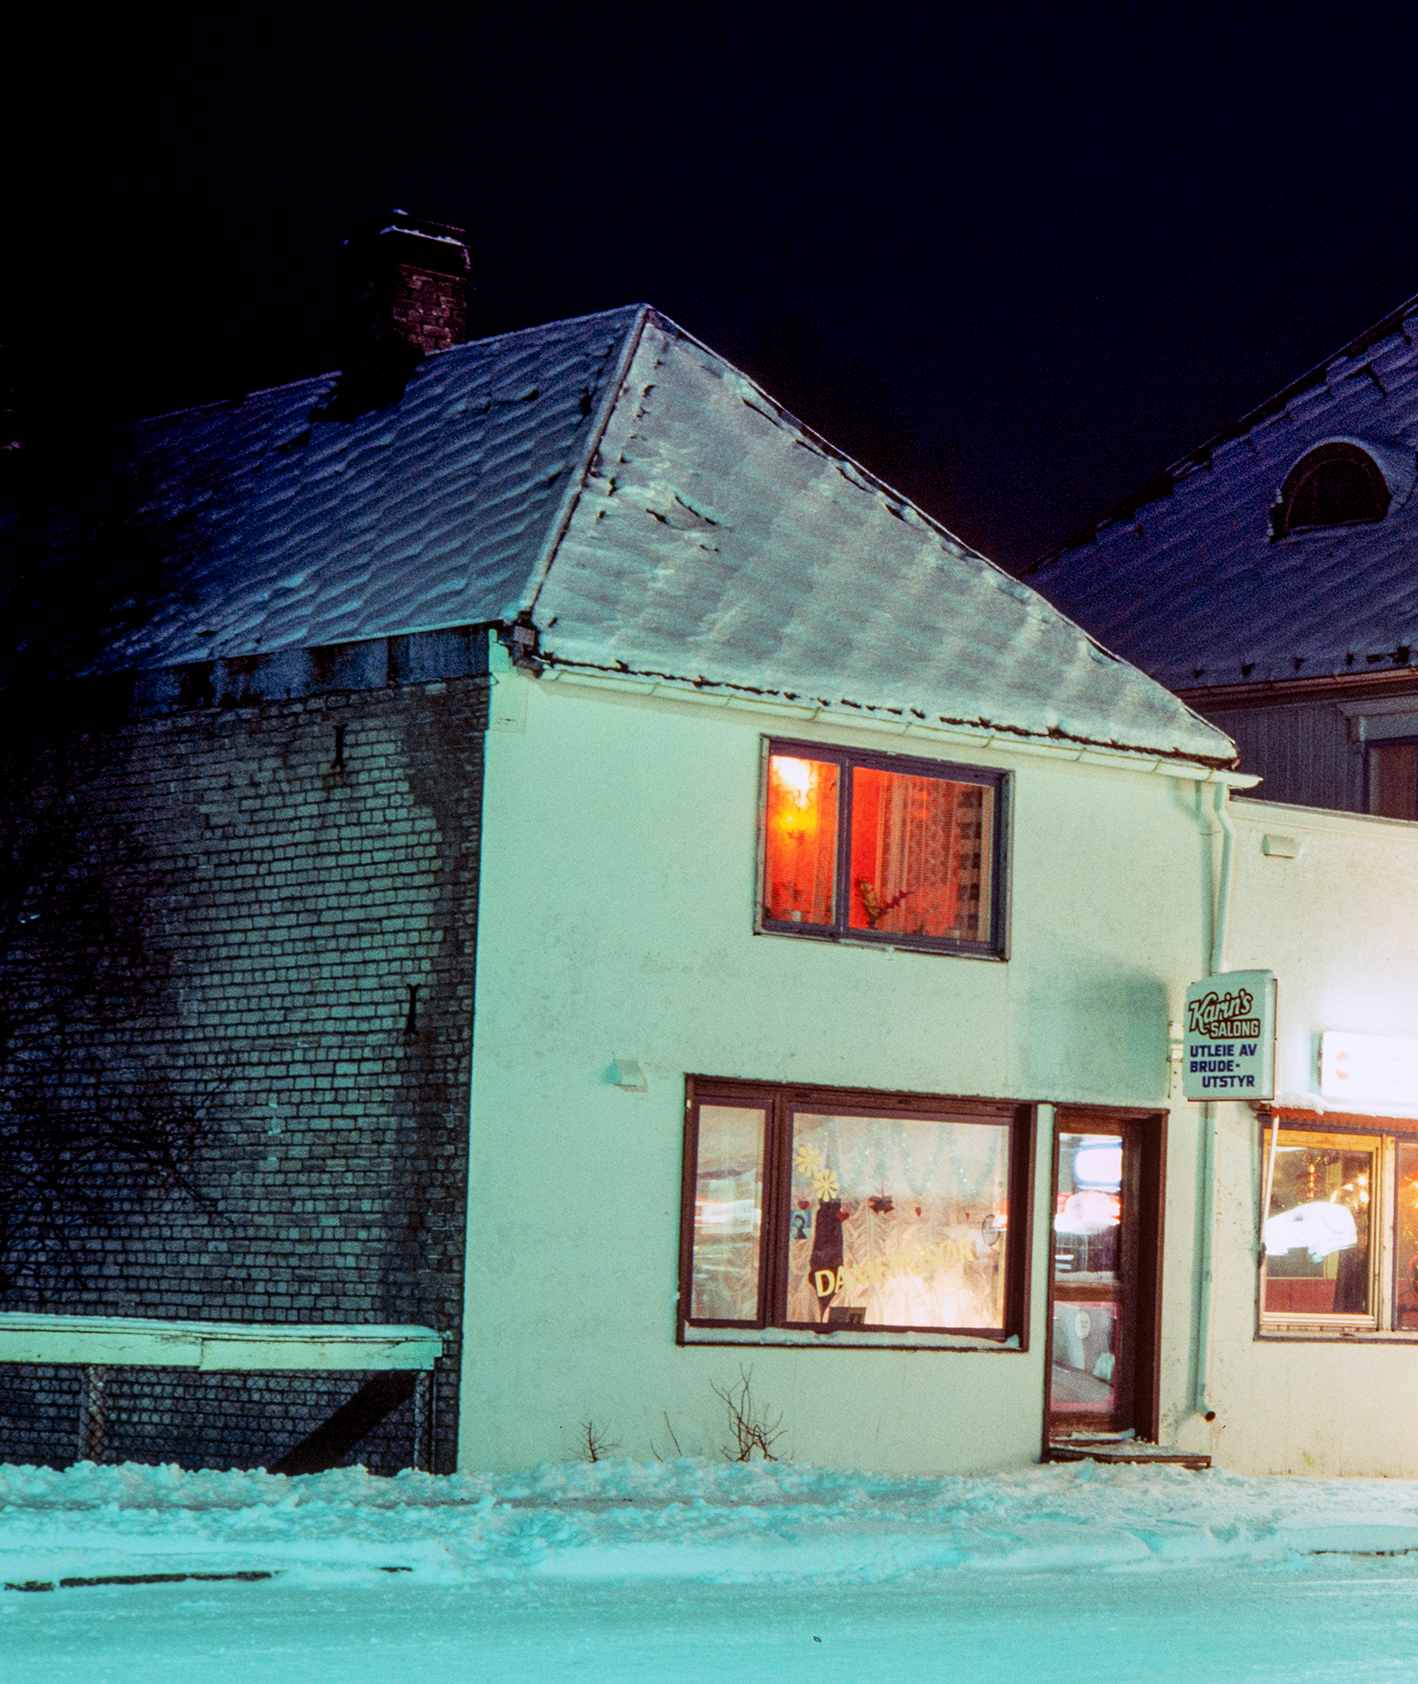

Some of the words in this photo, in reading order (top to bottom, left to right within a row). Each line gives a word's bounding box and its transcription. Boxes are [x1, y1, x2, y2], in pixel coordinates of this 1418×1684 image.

[1188, 988, 1253, 1035] Karin's
[1210, 1019, 1260, 1038] SALONG
[1190, 1044, 1235, 1057] UTLEIE
[1239, 1043, 1257, 1057] AV
[1190, 1060, 1241, 1073] BRUDE-
[1202, 1075, 1255, 1088] UTSTYR
